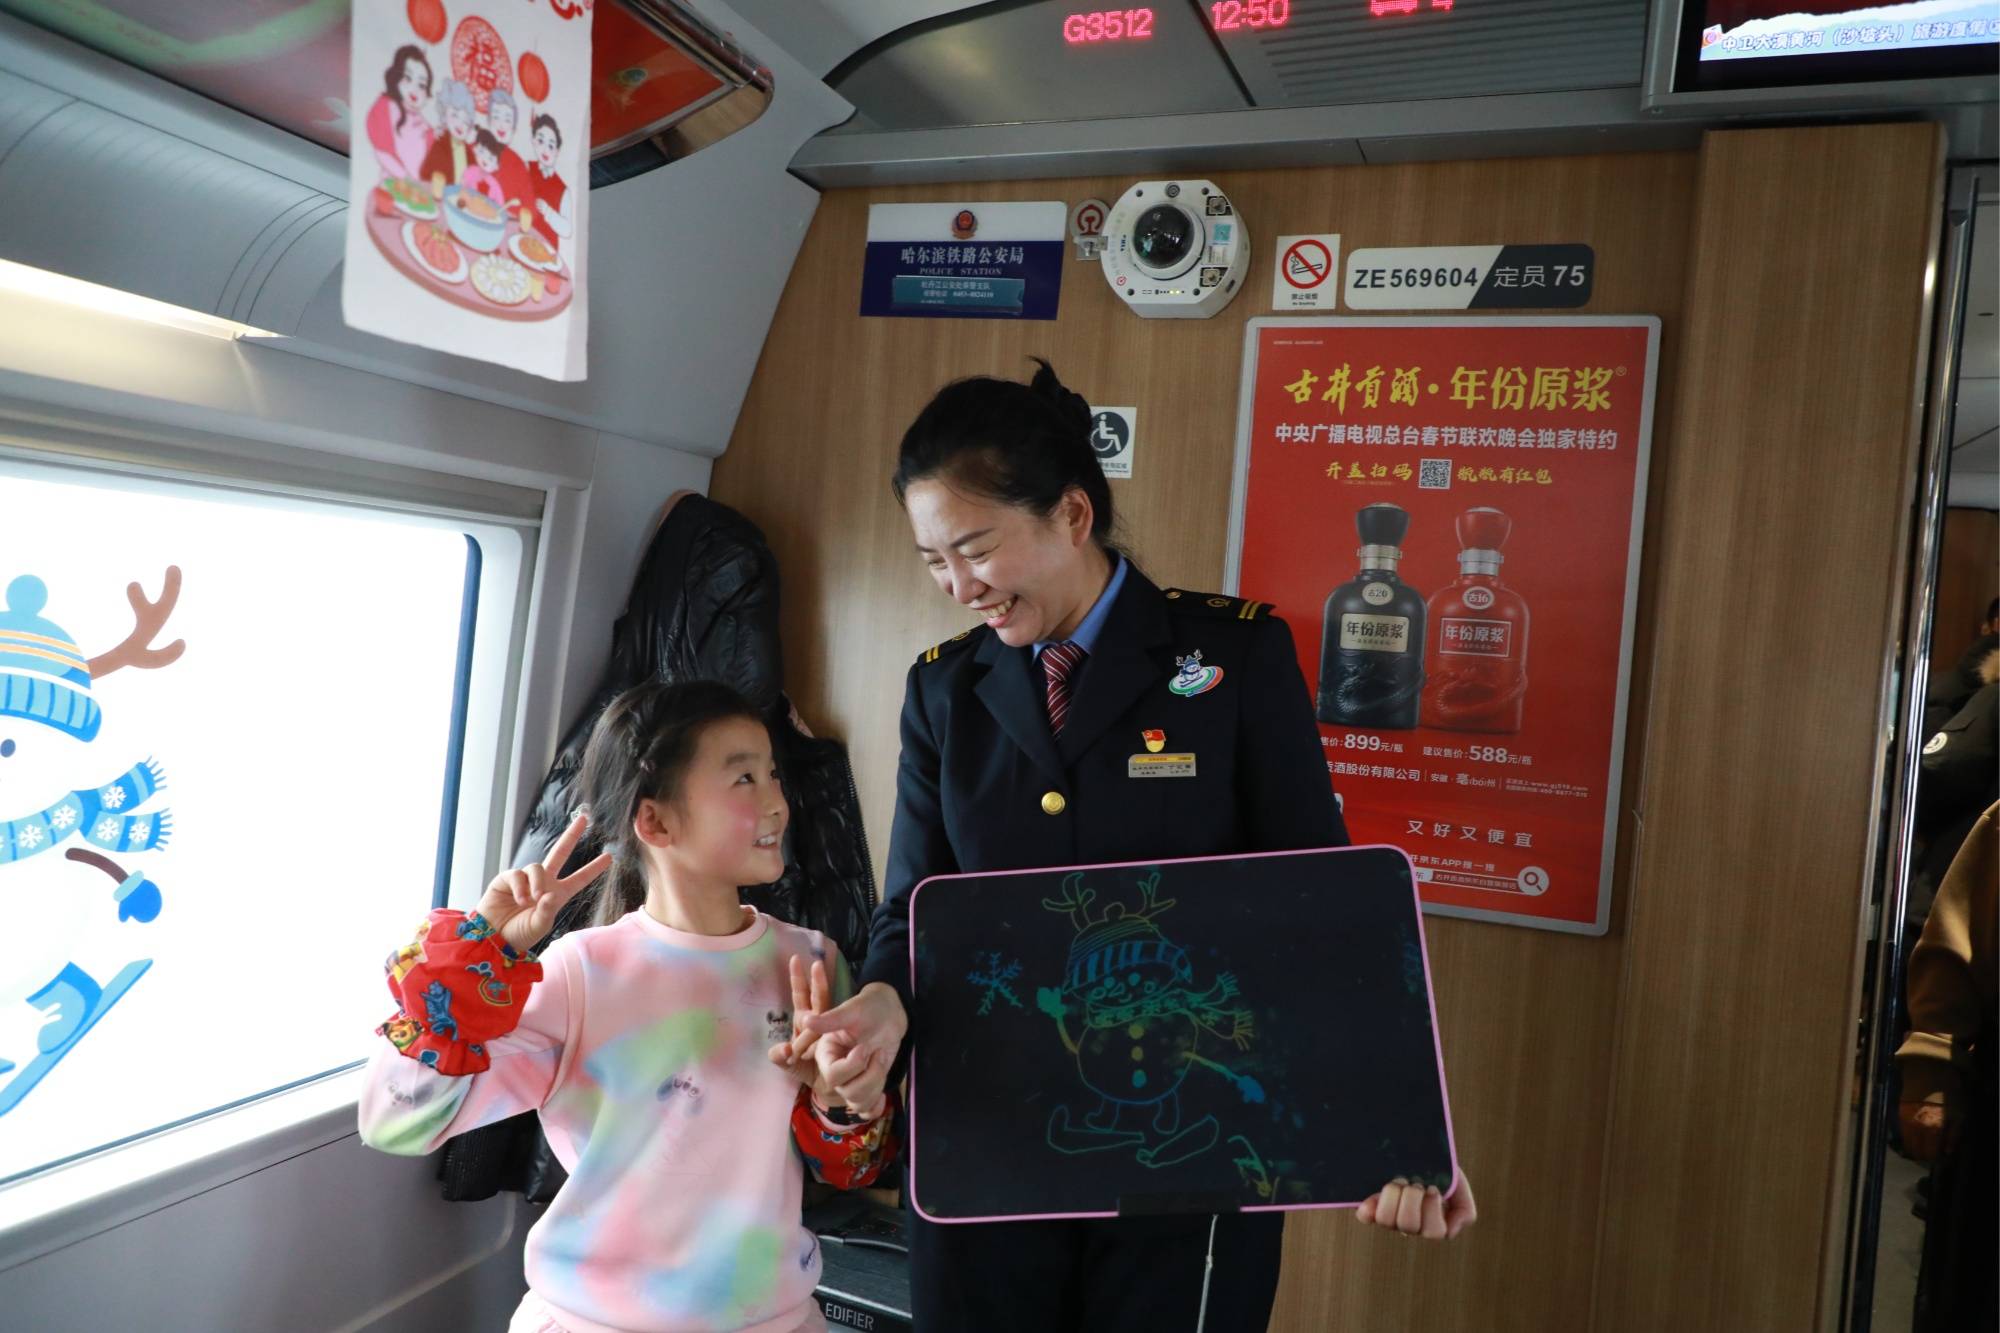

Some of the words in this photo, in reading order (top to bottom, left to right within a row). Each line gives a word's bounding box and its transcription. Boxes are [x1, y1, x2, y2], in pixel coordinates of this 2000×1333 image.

[1063, 8, 1153, 42] G3512
[1211, 0, 1290, 30] 12:50
[901, 246, 1025, 265] 哈尔滨铁路公安局
[920, 267, 953, 275] POLICE
[961, 267, 1002, 275] STATION
[1353, 267, 1478, 289] ZE569604
[1494, 265, 1546, 288] 定员
[1553, 265, 1586, 286] 75
[1275, 422, 1618, 451] 中央广播电视总台春节联欢晚会独家特约
[1325, 461, 1413, 482] 开盖扫码
[1346, 620, 1405, 640] 年份原浆
[1444, 624, 1504, 643] 年份原浆
[1406, 819, 1533, 848] 又好又便宜
[825, 1302, 875, 1331] EDIFIER
